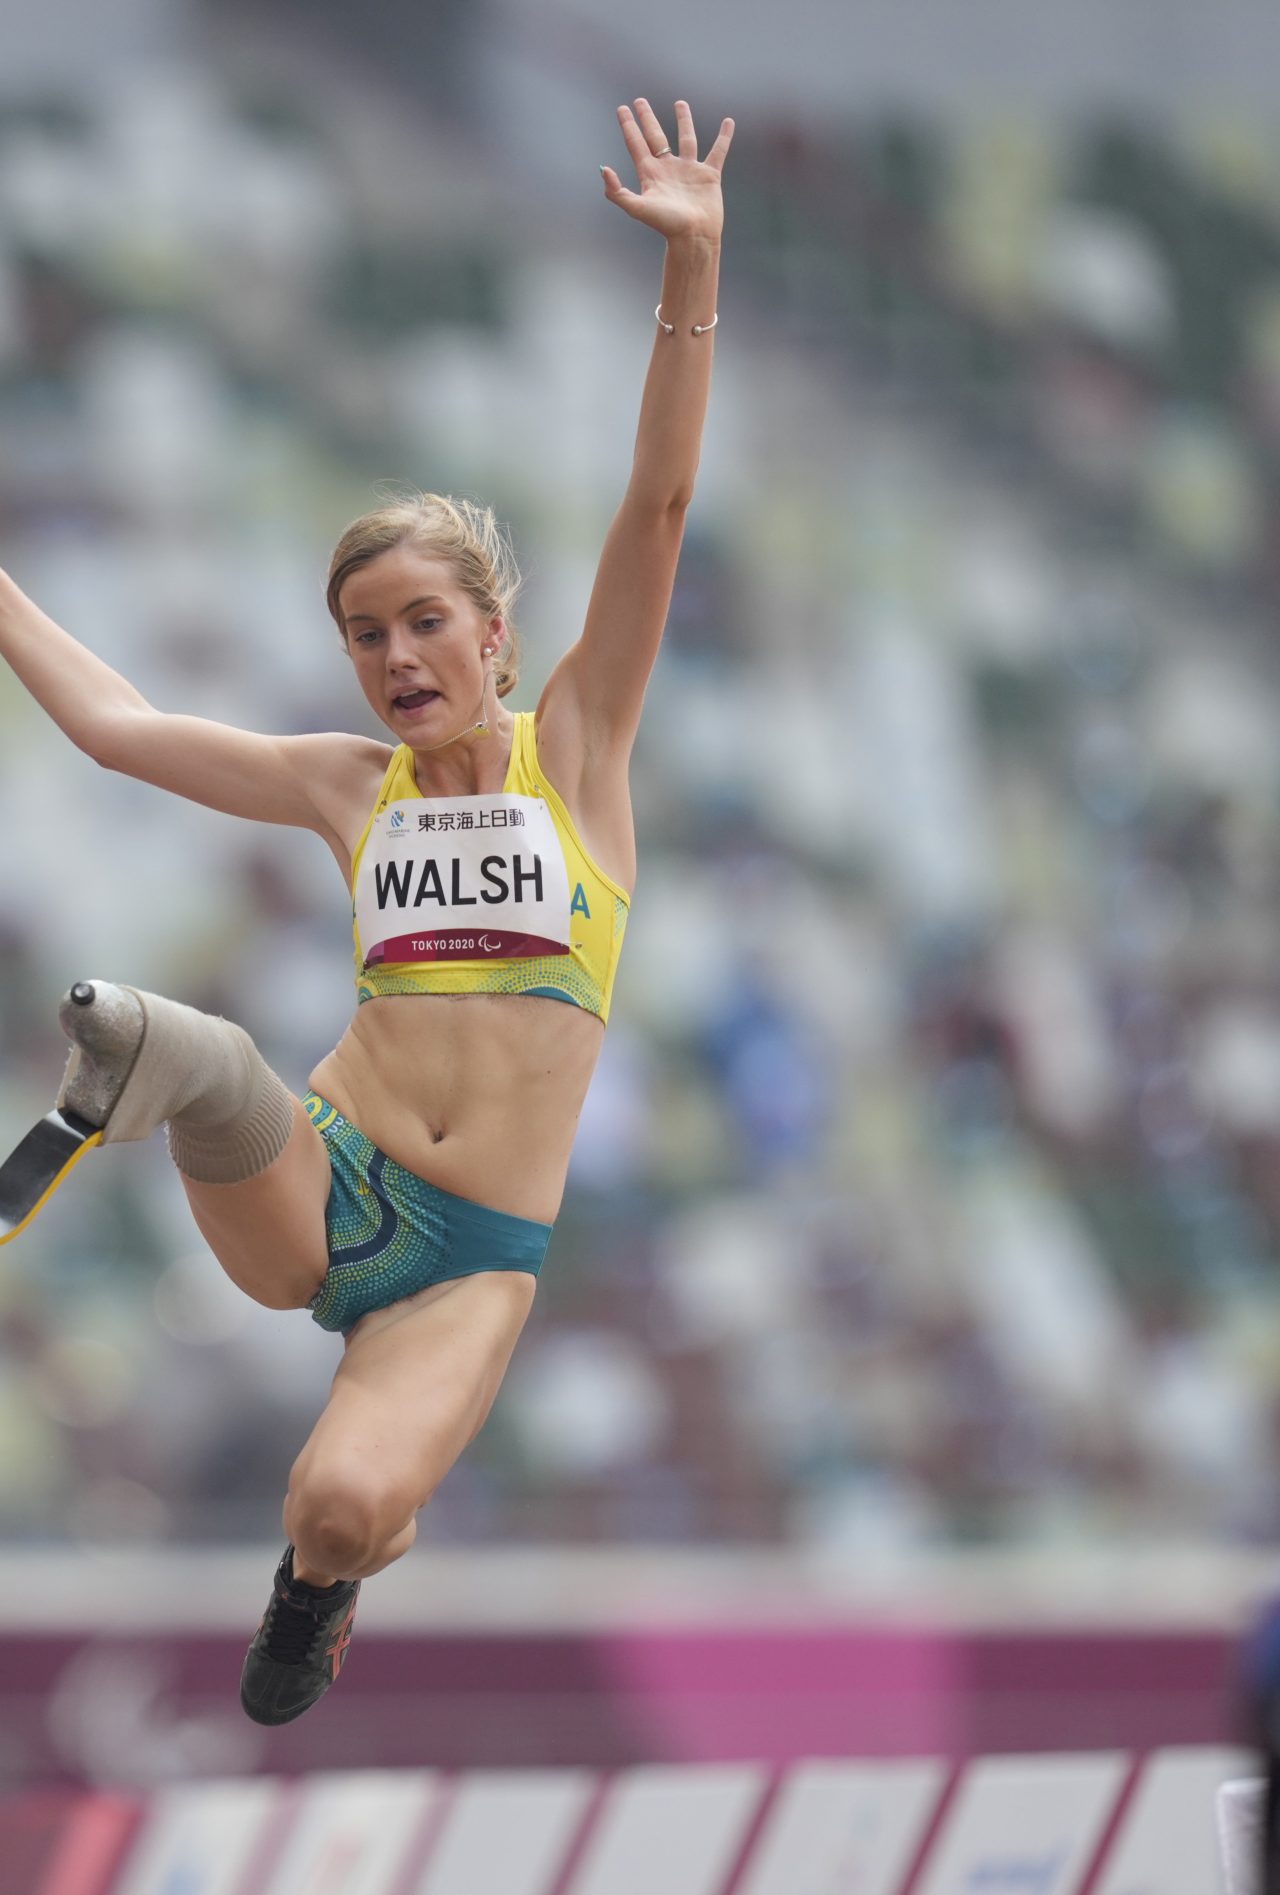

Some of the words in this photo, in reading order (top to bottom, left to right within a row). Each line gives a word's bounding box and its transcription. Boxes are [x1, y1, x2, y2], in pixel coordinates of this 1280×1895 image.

[418, 808, 525, 832] 東京海上日動
[375, 854, 544, 910] WALSH
[411, 940, 447, 951] TOKYO
[448, 939, 475, 950] 2020
